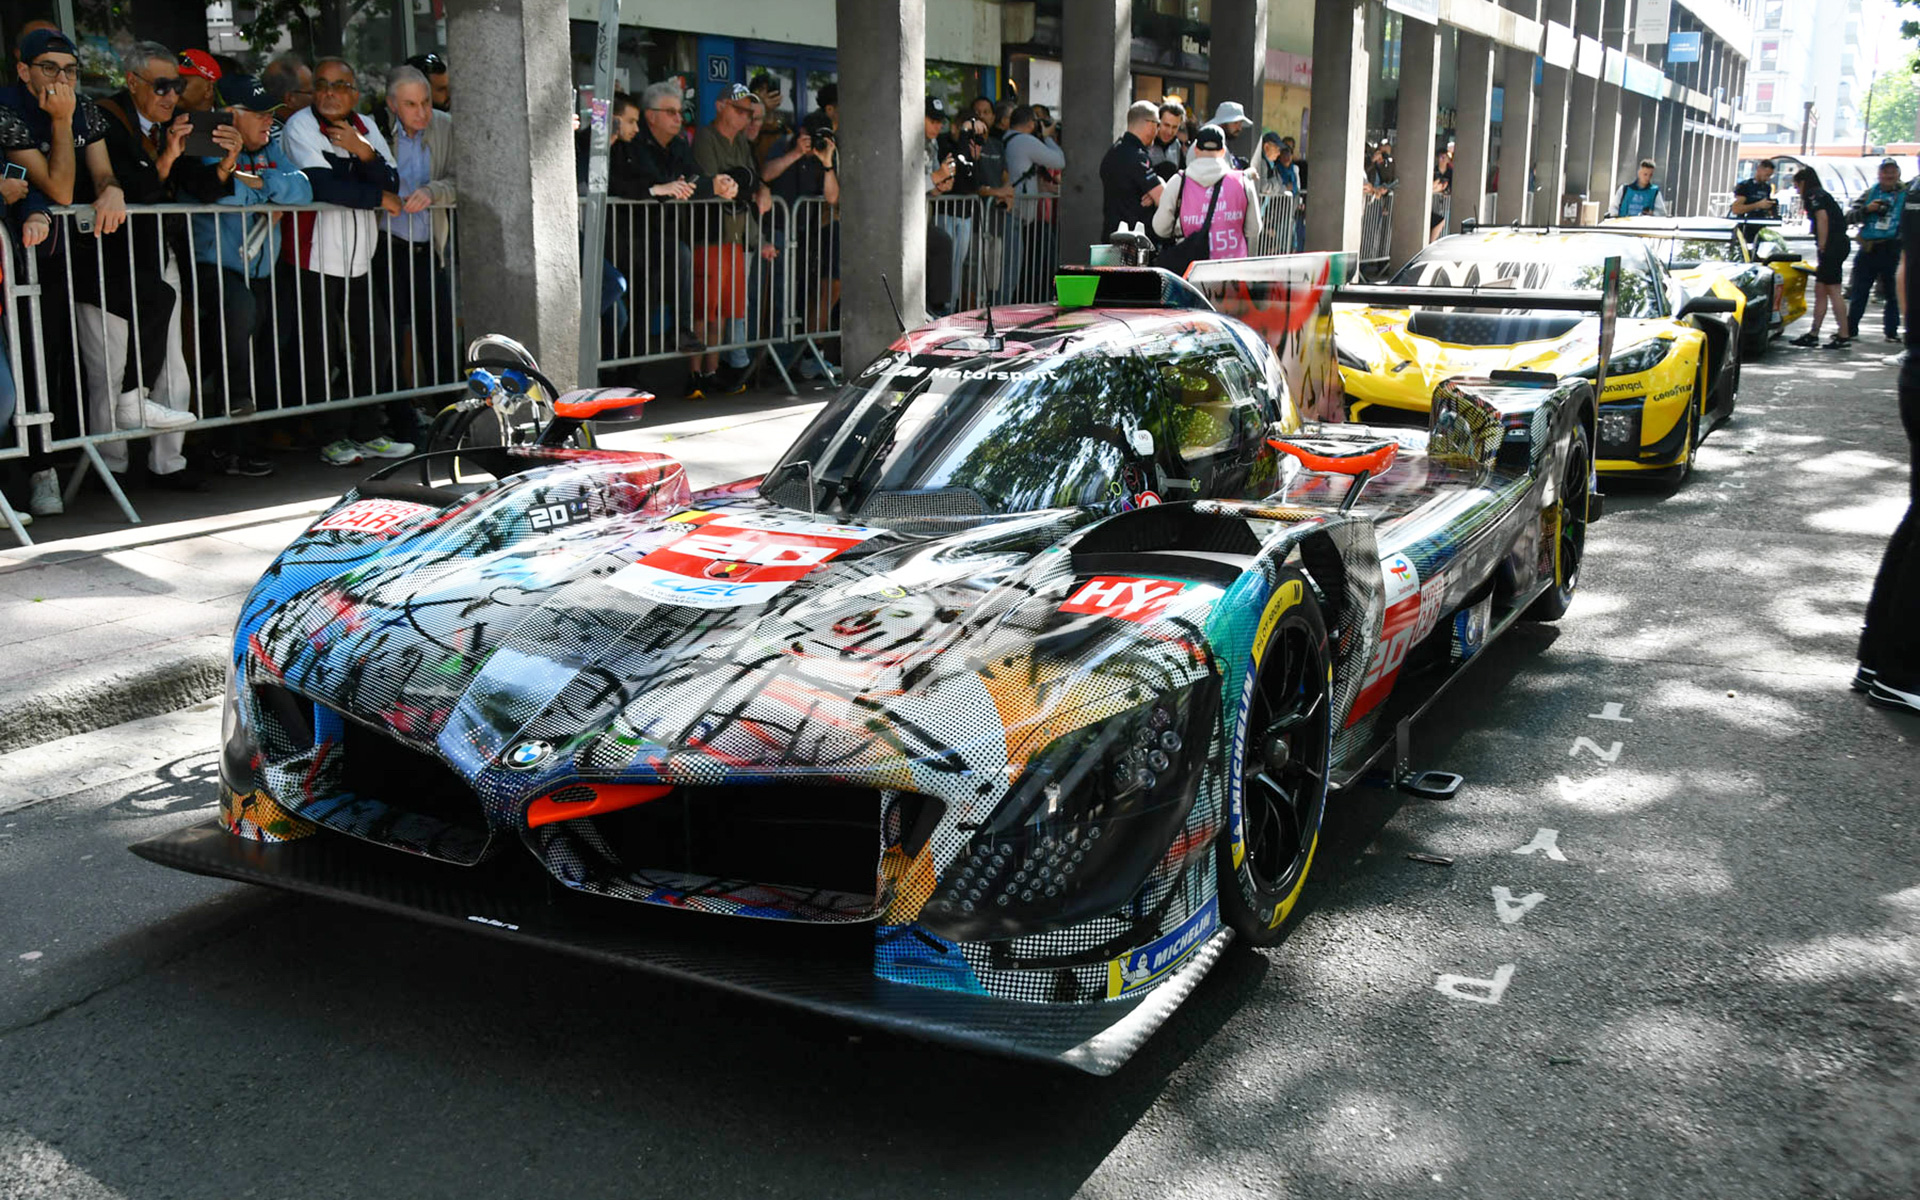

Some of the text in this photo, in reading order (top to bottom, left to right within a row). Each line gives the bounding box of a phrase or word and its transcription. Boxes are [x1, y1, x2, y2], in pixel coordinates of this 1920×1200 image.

[712, 59, 727, 78] 50
[1201, 200, 1227, 213] MDIA
[1208, 228, 1239, 252] 155
[928, 367, 1058, 383] Motorsport
[1601, 381, 1644, 394] onangol
[322, 510, 400, 530] CAR
[528, 504, 569, 529] 20
[667, 534, 838, 567] 20
[650, 578, 759, 597] WEC
[1232, 671, 1253, 815] MICHELIN
[1152, 911, 1212, 969] MICHELIN
